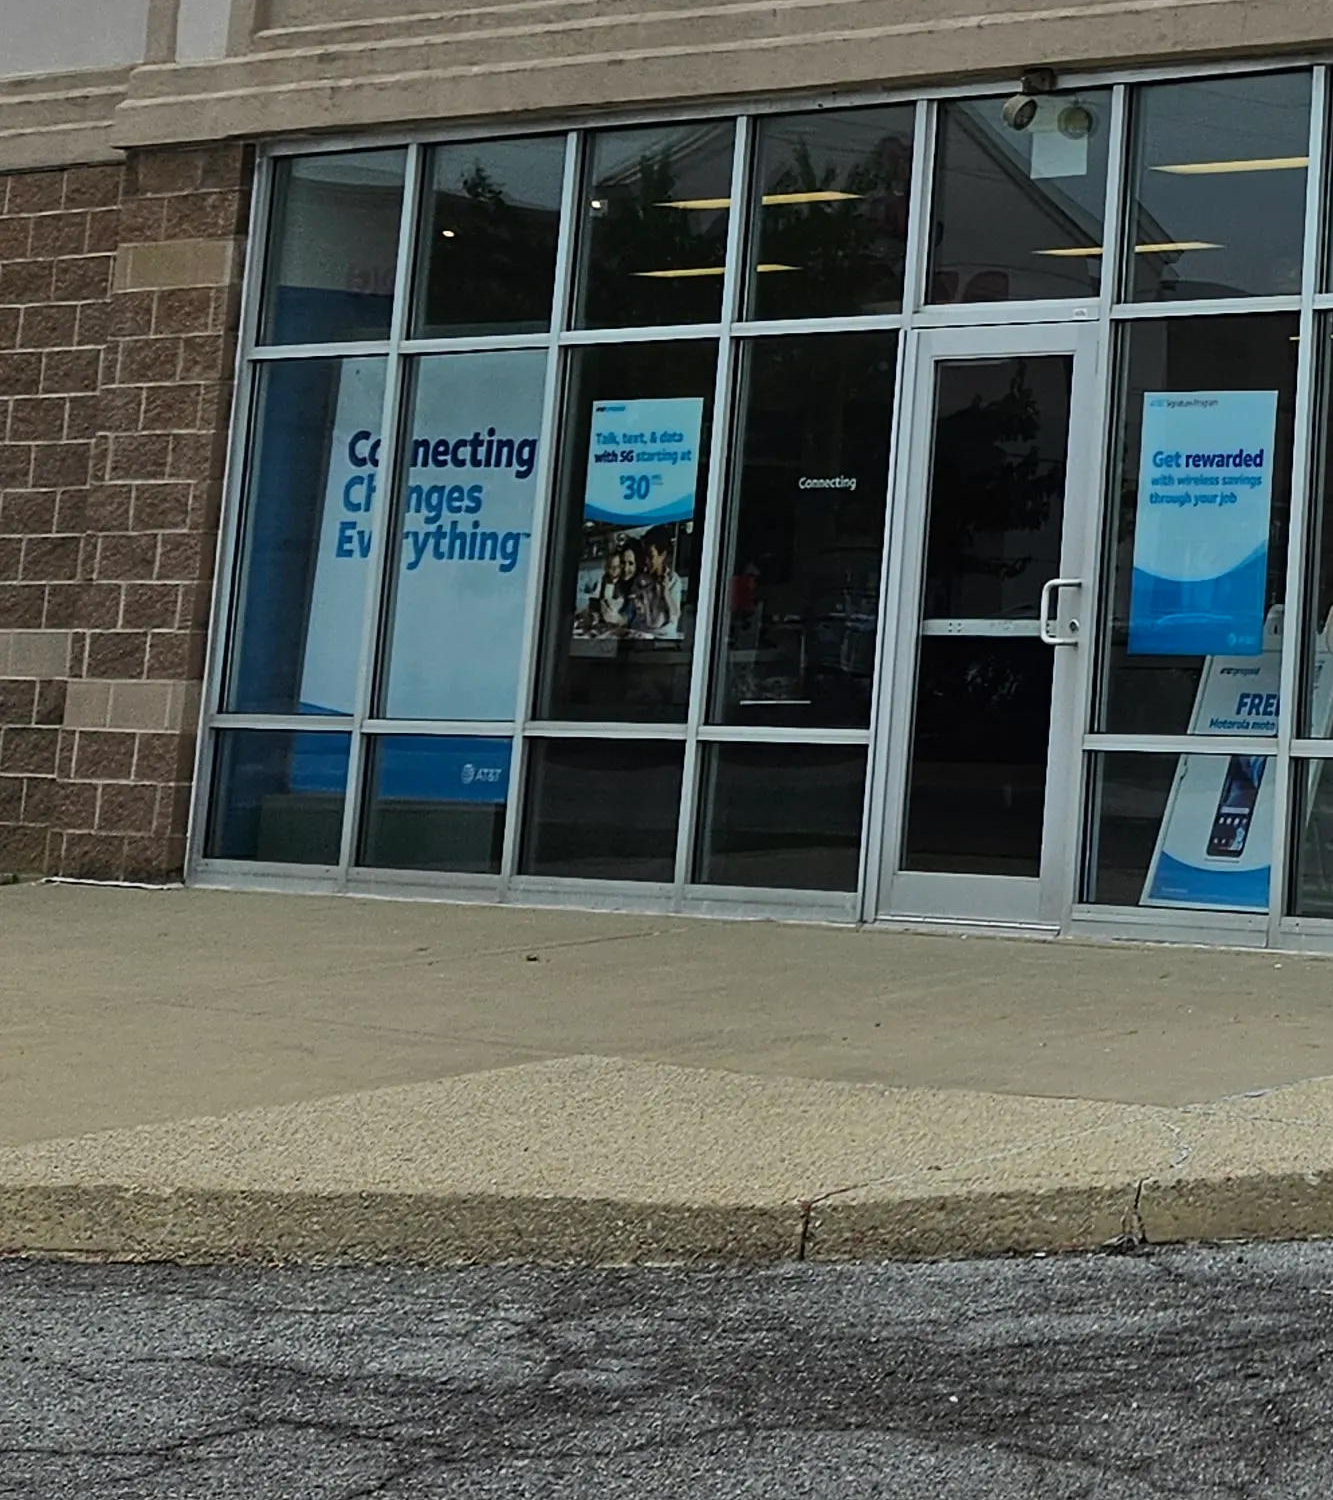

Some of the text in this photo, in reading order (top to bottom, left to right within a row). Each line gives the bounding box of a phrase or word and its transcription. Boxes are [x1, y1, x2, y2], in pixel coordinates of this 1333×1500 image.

[349, 427, 538, 479] Conecting
[1152, 448, 1264, 468] Get rewarded
[799, 475, 857, 491] Connecting
[1151, 474, 1174, 486] with
[343, 472, 483, 525] Chnges
[1149, 492, 1192, 507] through
[1218, 492, 1238, 507] job
[1236, 693, 1280, 717] FRE
[1209, 718, 1276, 730] Motorola moto
